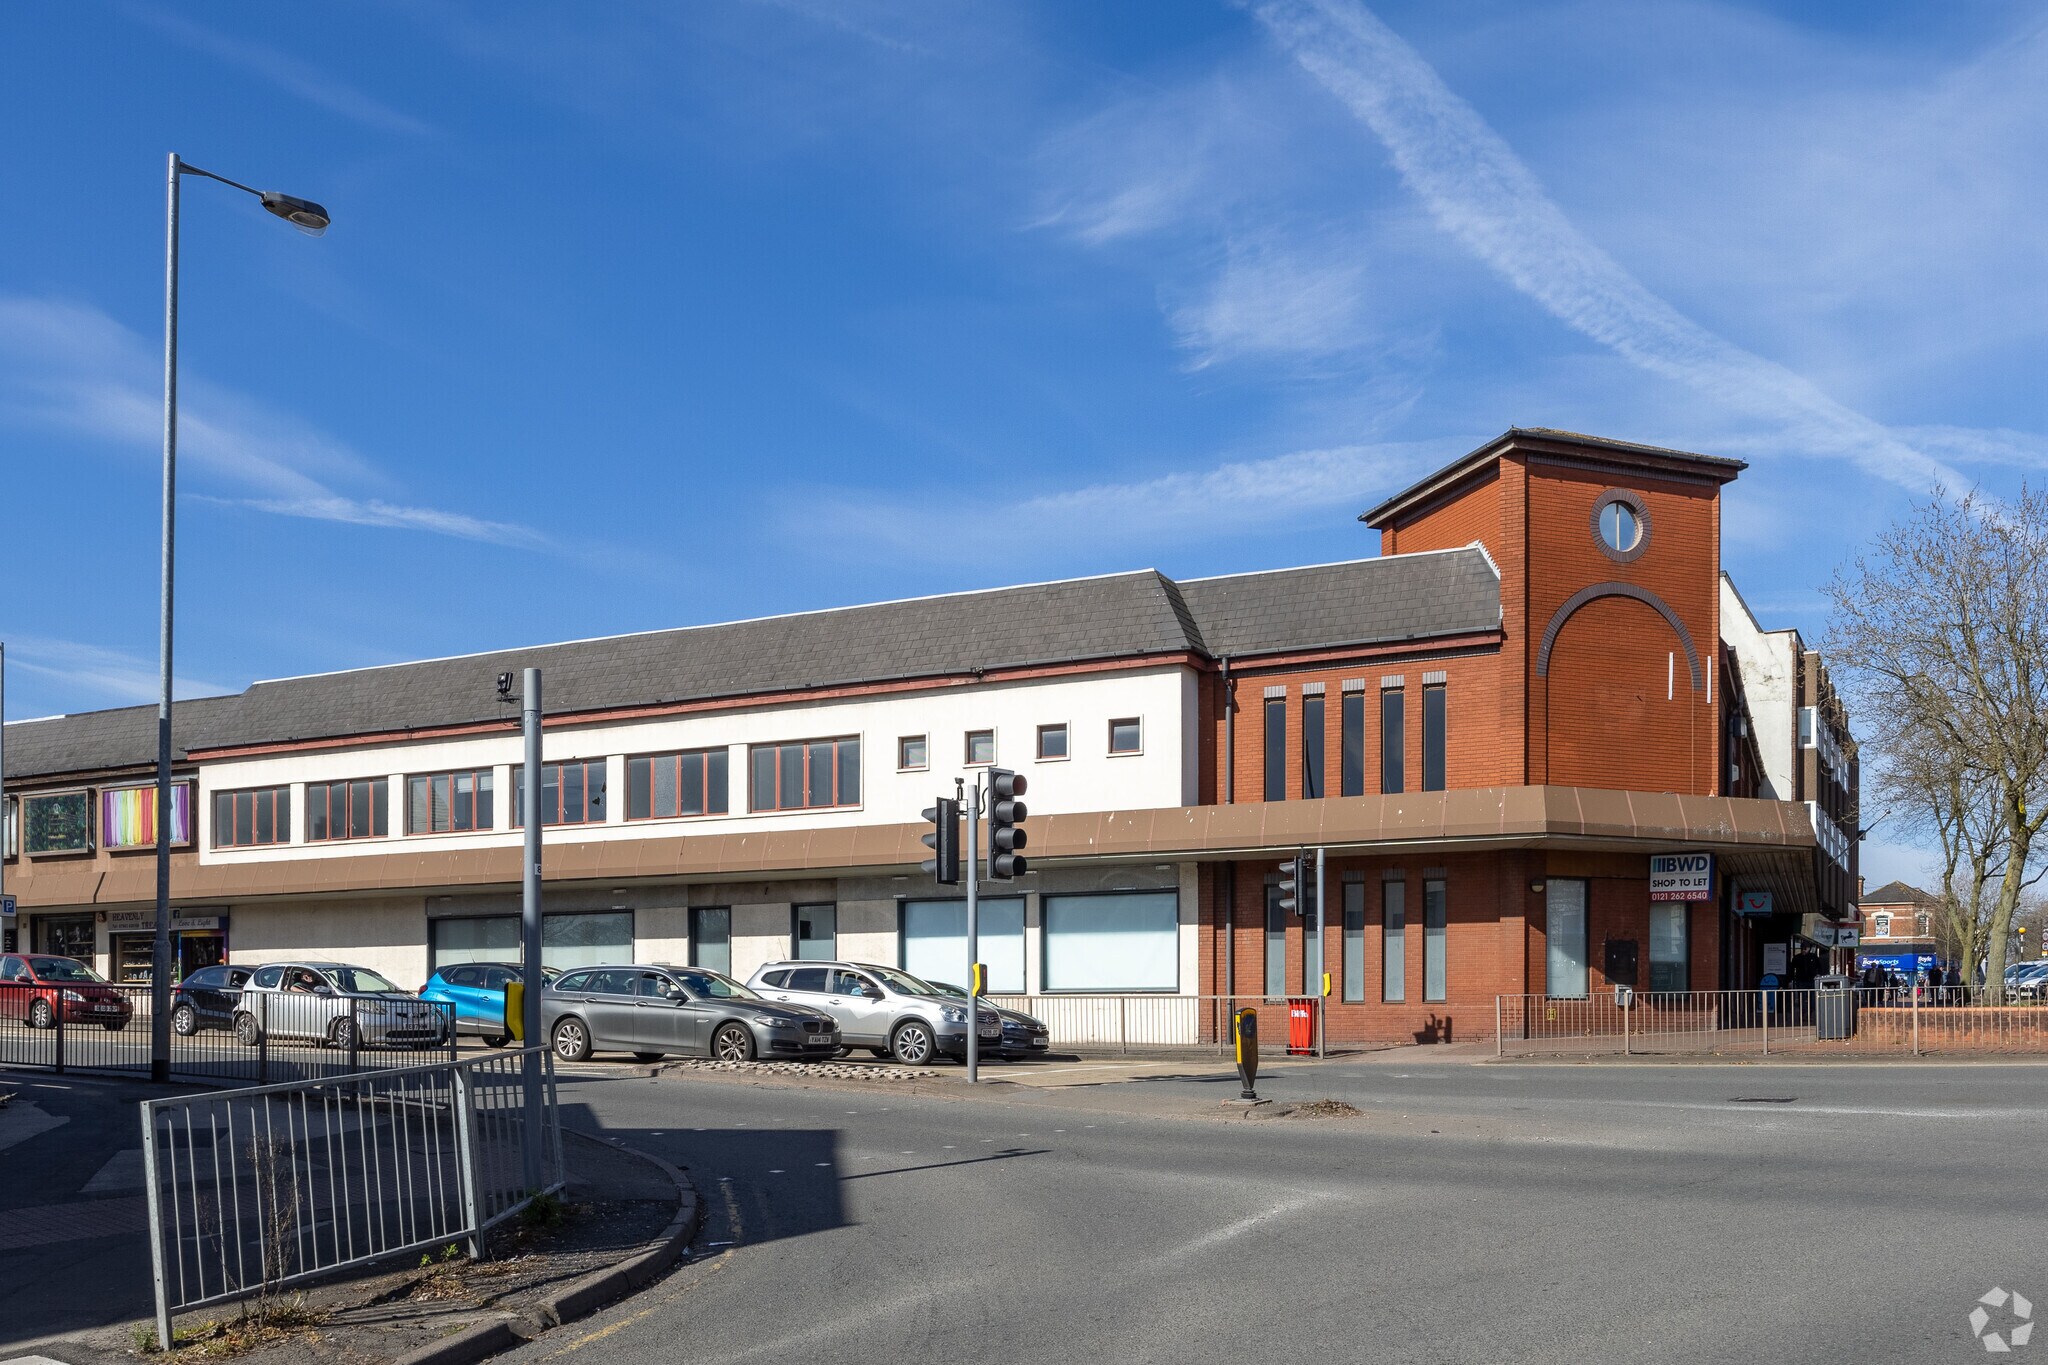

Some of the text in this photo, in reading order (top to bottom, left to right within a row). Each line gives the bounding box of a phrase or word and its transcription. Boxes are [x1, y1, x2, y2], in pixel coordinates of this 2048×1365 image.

[1652, 878, 1708, 888] SHOP TO LET
[1651, 891, 1708, 901] 0121 262 6540
[5, 901, 13, 912] P
[112, 912, 145, 921] HEAVENLY
